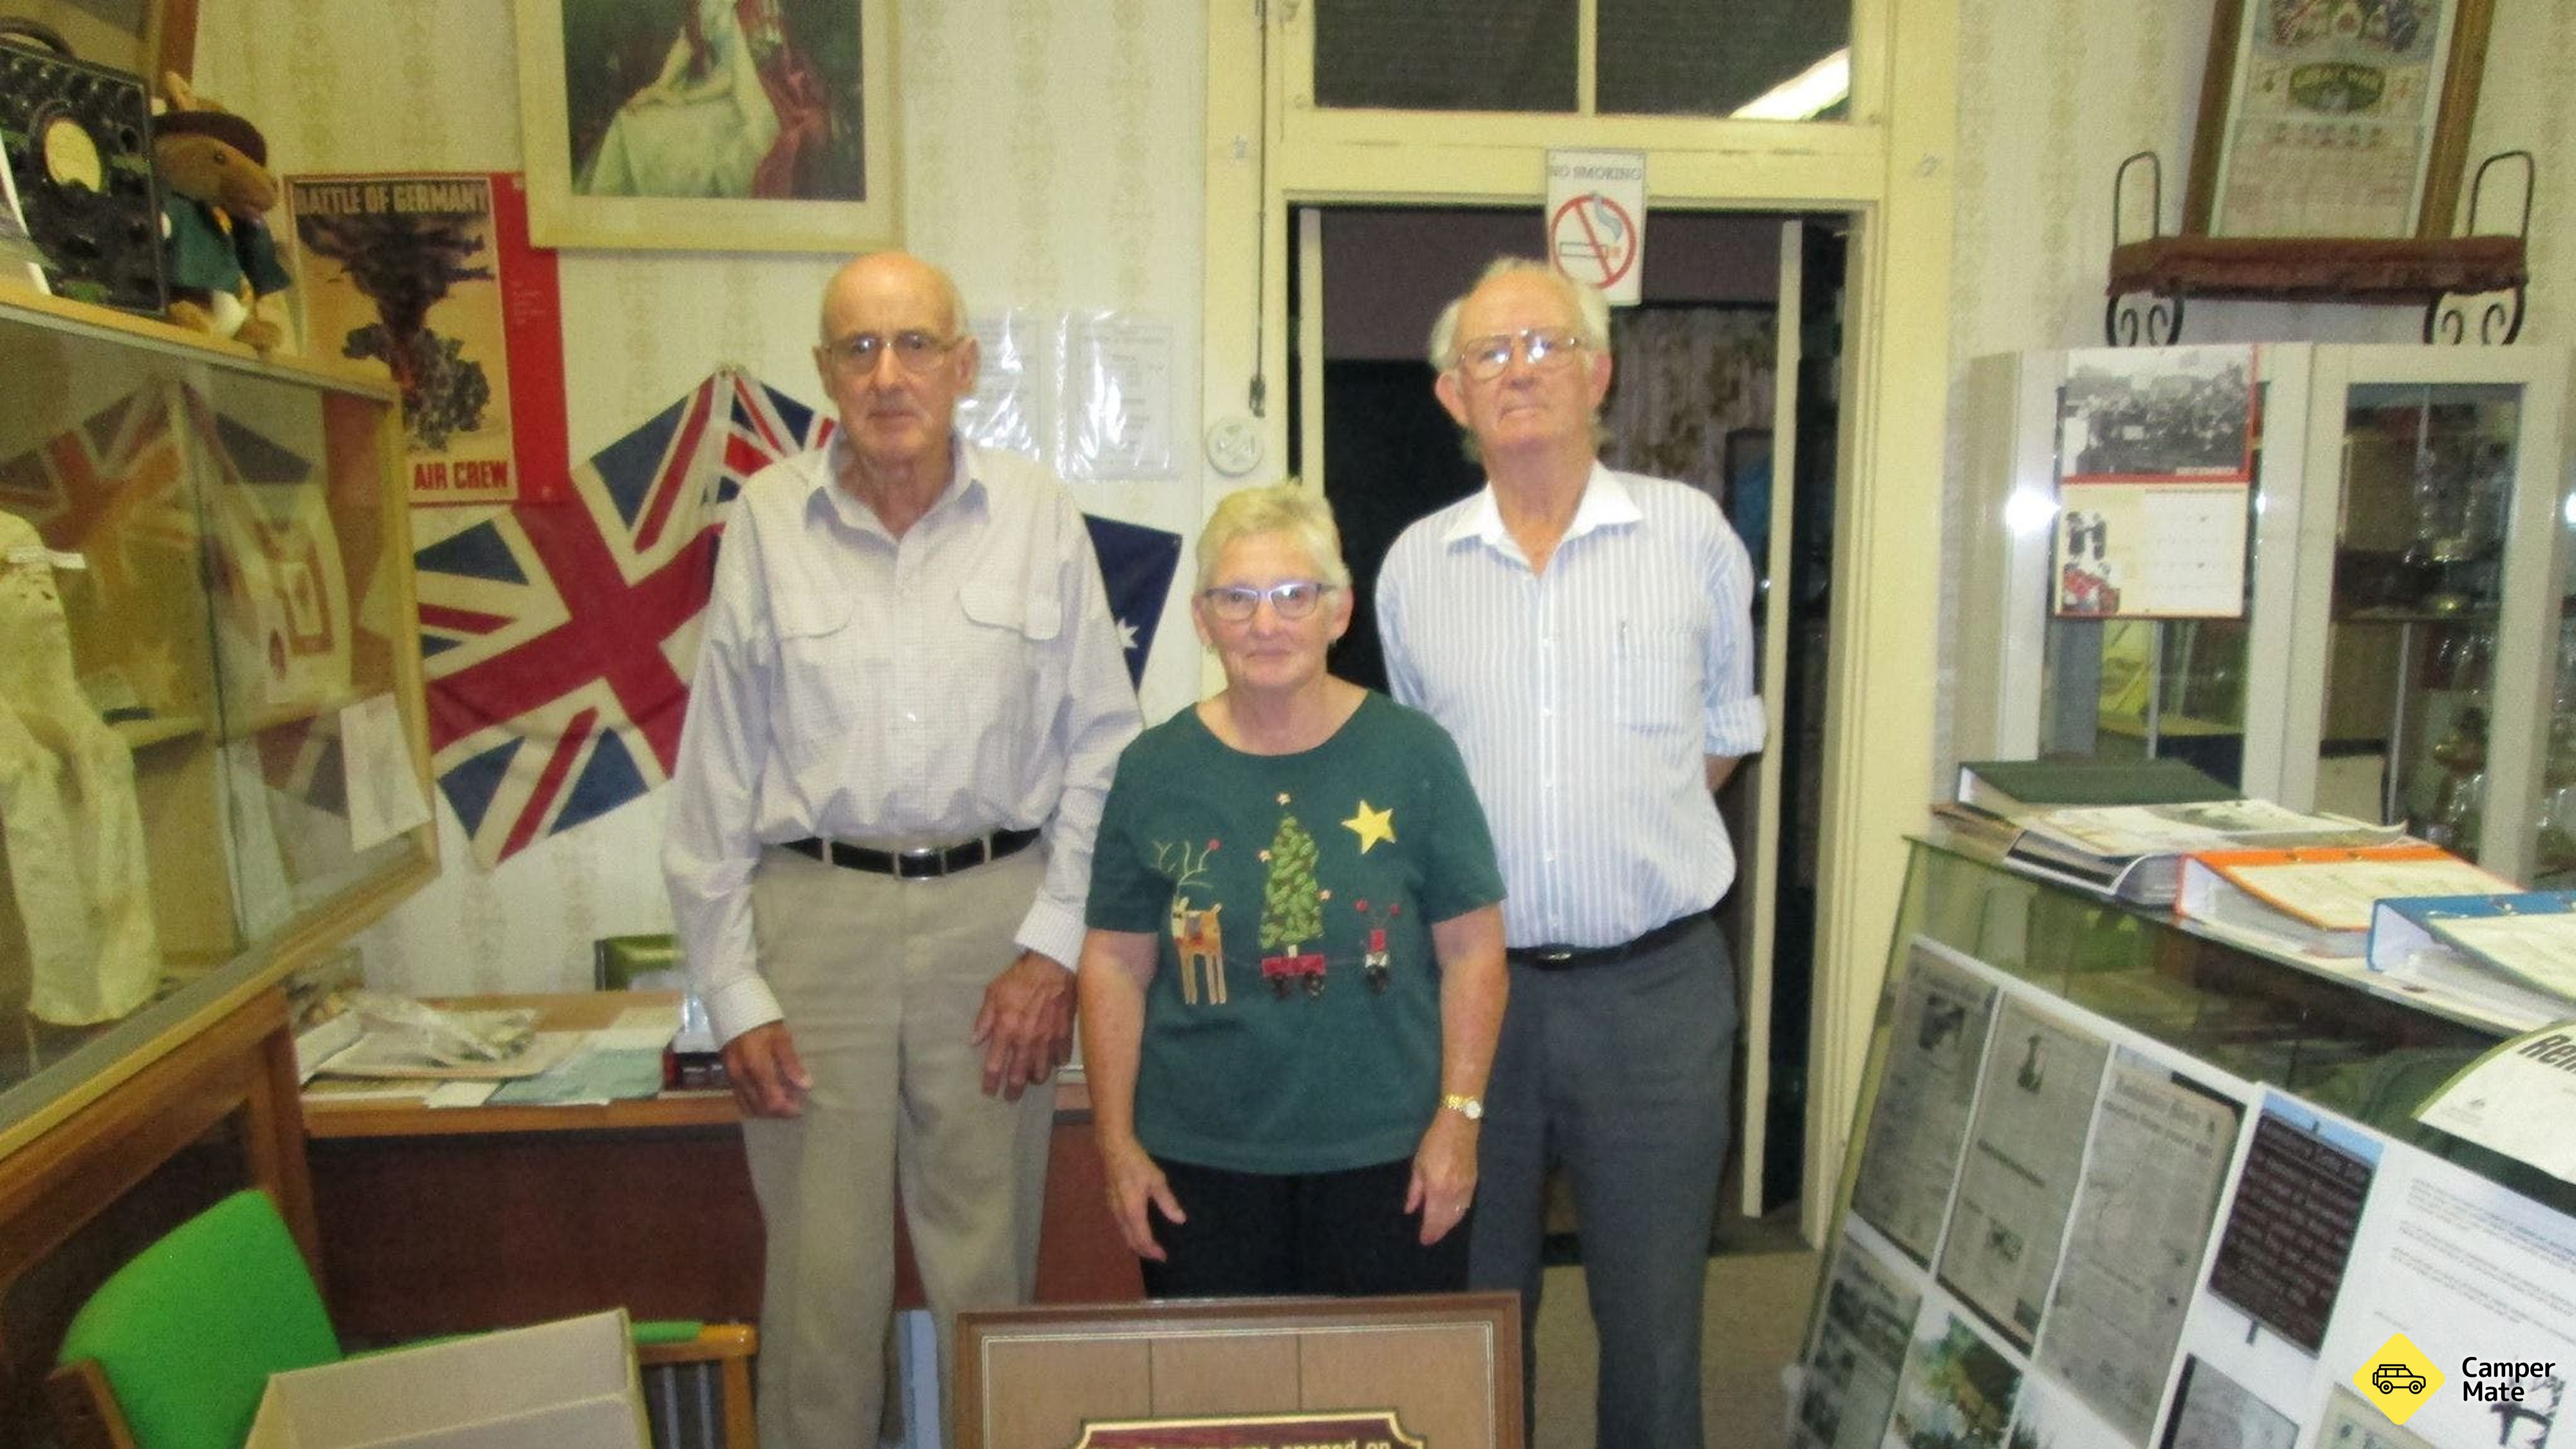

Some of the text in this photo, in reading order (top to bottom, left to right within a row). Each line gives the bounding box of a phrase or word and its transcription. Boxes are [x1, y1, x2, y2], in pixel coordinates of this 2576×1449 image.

[1548, 164, 1643, 181] NO SMOKING
[295, 183, 489, 214] BATTLE OF GERMANY
[413, 460, 509, 491] AIR CREW
